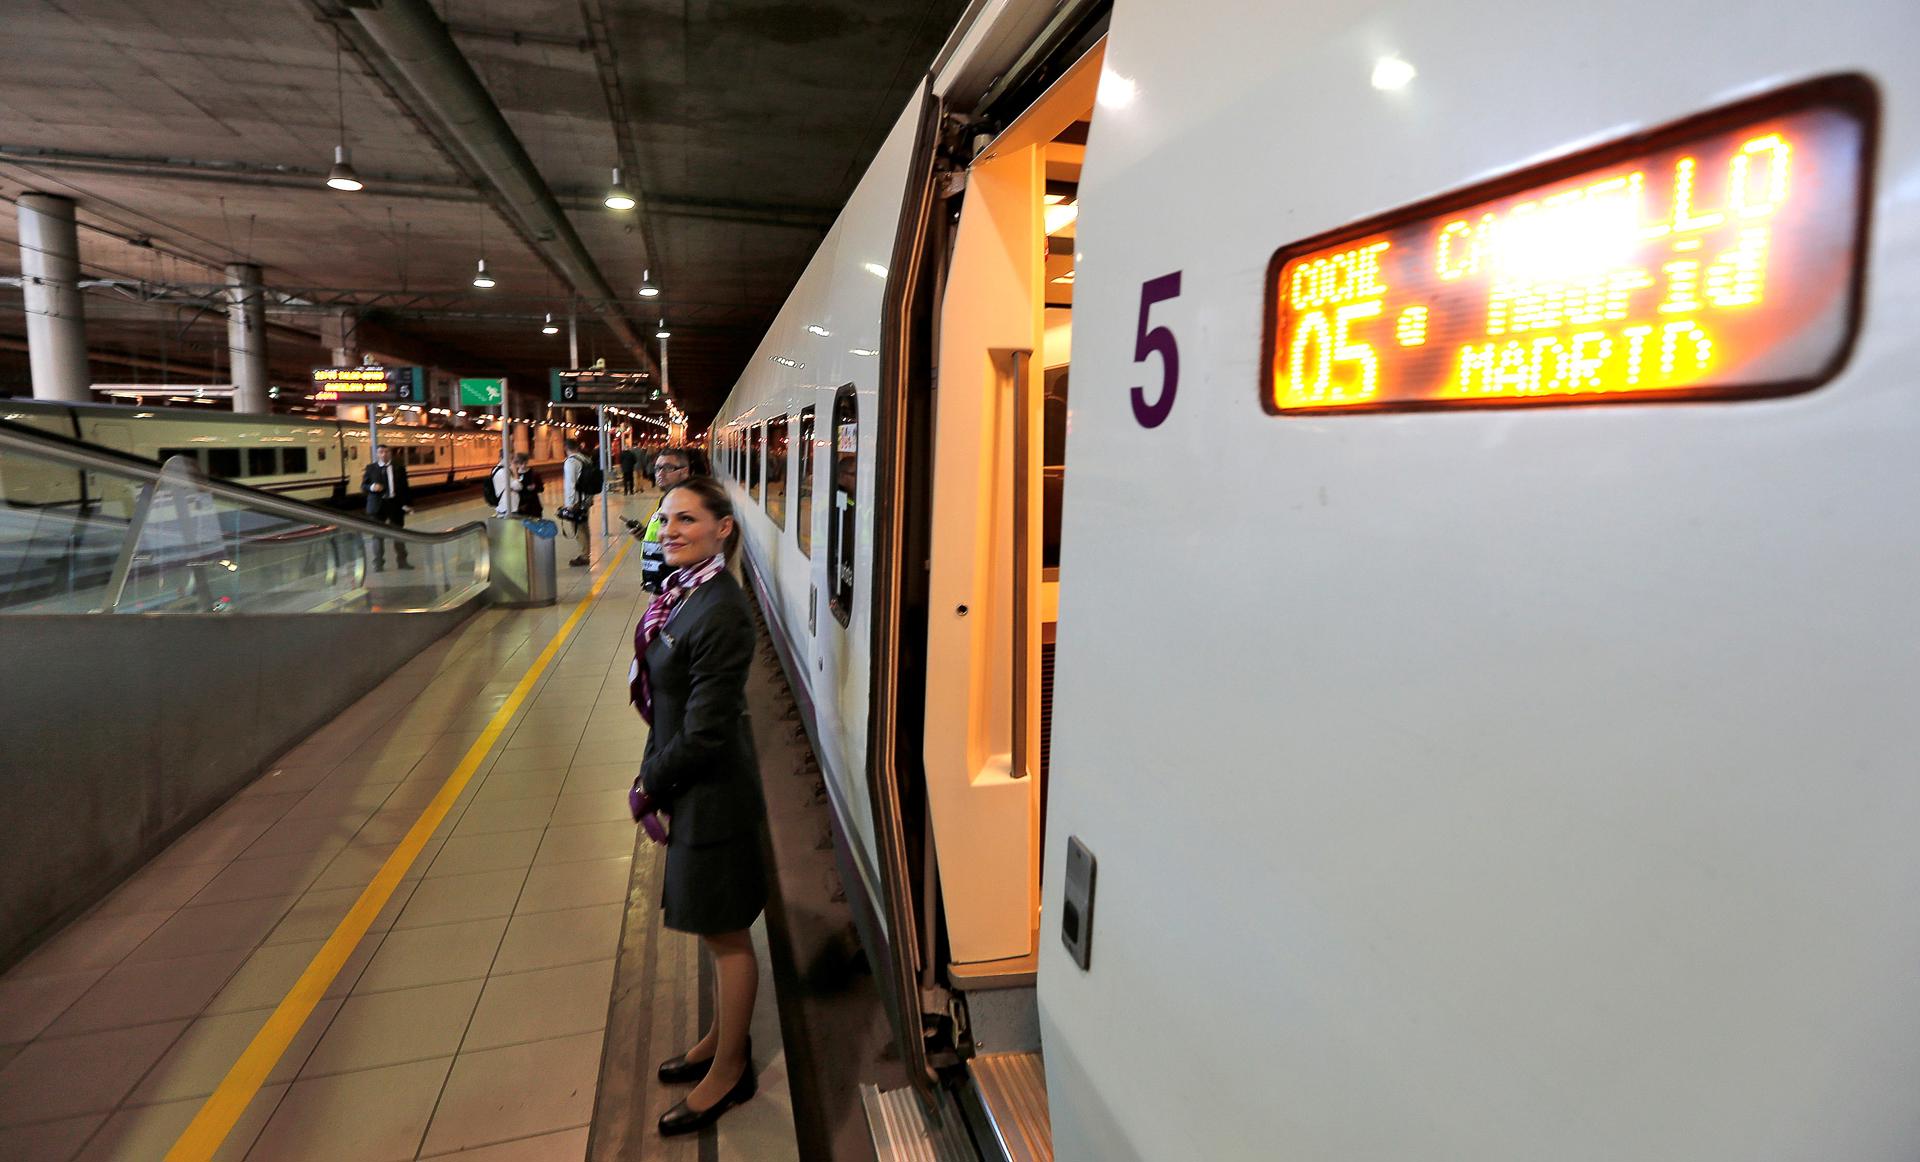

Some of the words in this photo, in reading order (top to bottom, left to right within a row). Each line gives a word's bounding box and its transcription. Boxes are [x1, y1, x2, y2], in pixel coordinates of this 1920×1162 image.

[1437, 133, 1792, 281] CALLO
[1291, 241, 1391, 311] COCHE
[1130, 270, 1183, 429] 5
[1289, 299, 1384, 399] 05
[1458, 320, 1713, 395] MADRID
[399, 384, 410, 398] 5
[564, 386, 574, 399] 6
